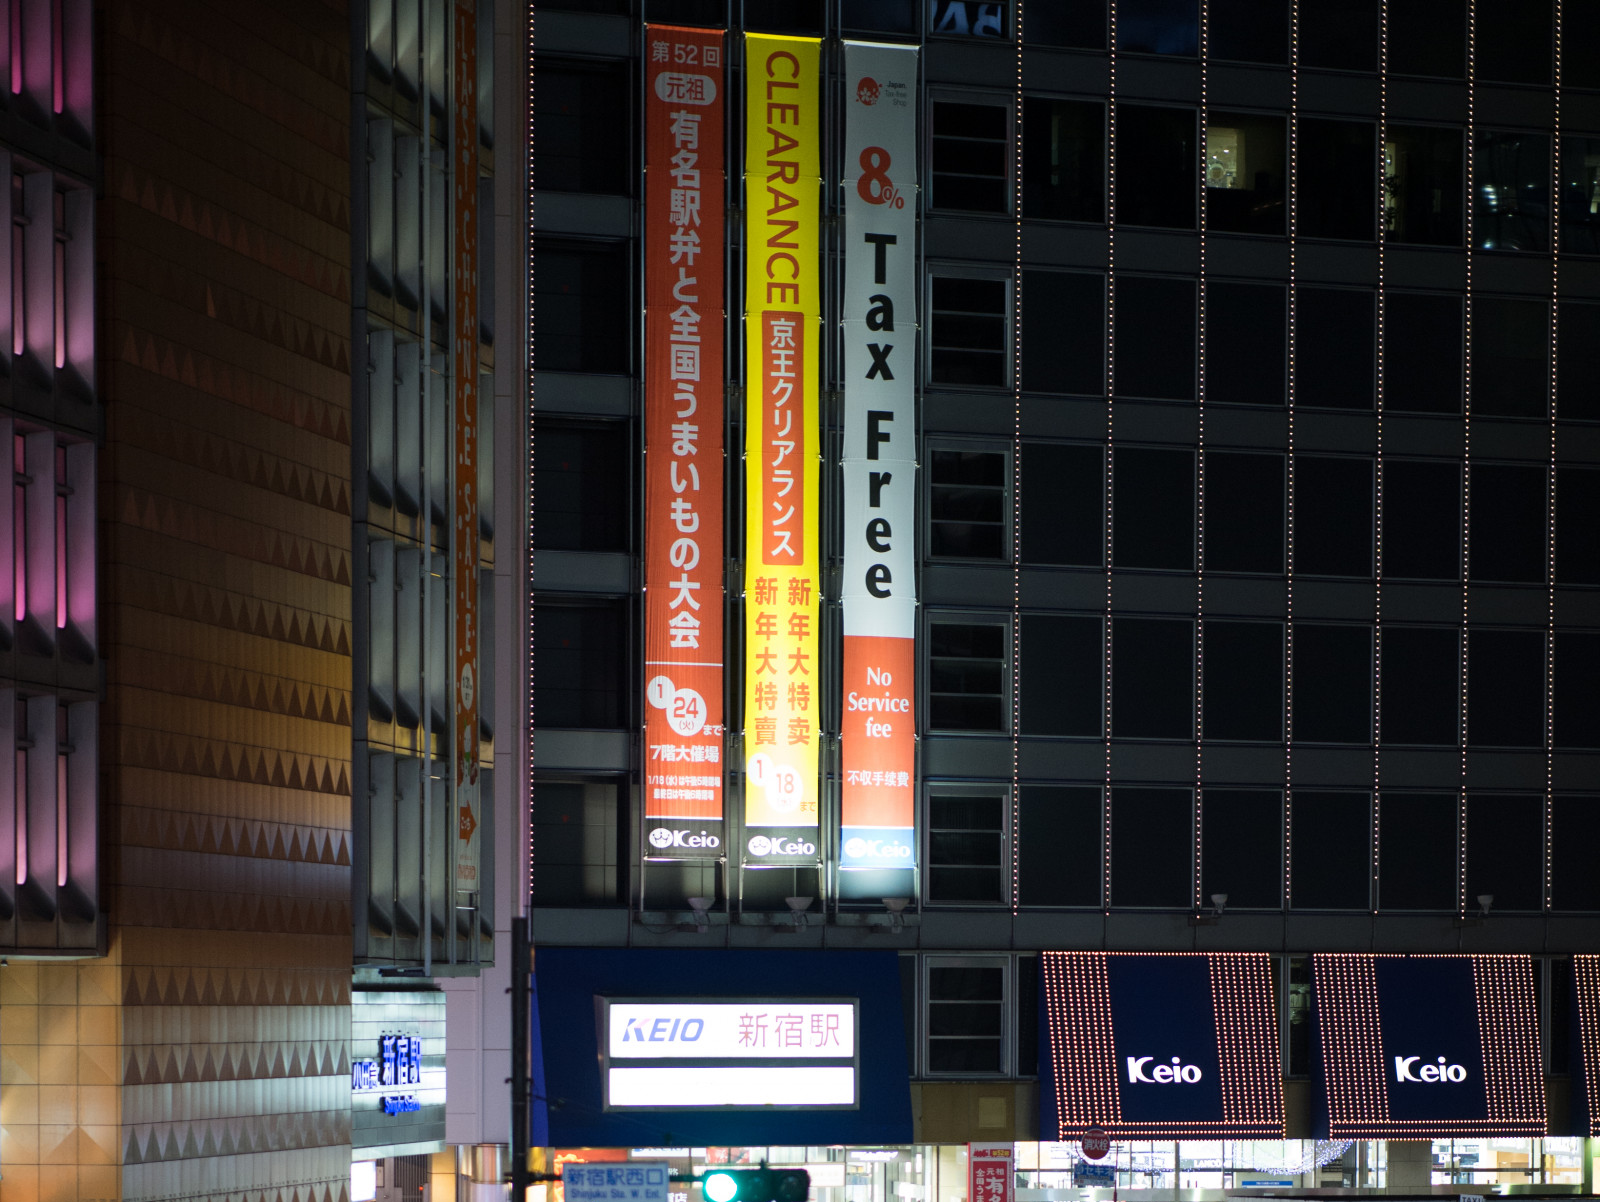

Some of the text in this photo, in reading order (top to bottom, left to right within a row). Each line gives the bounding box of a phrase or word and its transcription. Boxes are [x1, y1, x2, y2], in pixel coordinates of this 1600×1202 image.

[652, 40, 720, 68] 第52回
[666, 77, 705, 101] 元祖
[765, 50, 800, 305] CLEARANCE
[857, 146, 904, 210] 8%
[668, 110, 702, 649] 有名駅弁と全国うまいもの大会
[864, 232, 898, 599] Tax Free
[770, 318, 796, 557] 京王クリアランス
[866, 666, 892, 687] No
[848, 692, 910, 713] Service
[865, 716, 892, 739] fee
[650, 744, 720, 763] 7階大催場
[673, 830, 720, 848] Keio
[771, 835, 815, 855] Keio
[867, 839, 910, 858] Keio
[622, 1018, 704, 1042] KEIO
[738, 1013, 840, 1048] 新宿駅
[383, 1035, 422, 1085] 新宿駅
[1127, 1056, 1202, 1084] Keio
[1394, 1055, 1467, 1083] Keio
[1084, 1138, 1109, 1151] 消火栓
[568, 1168, 664, 1186] 新宿駅西口
